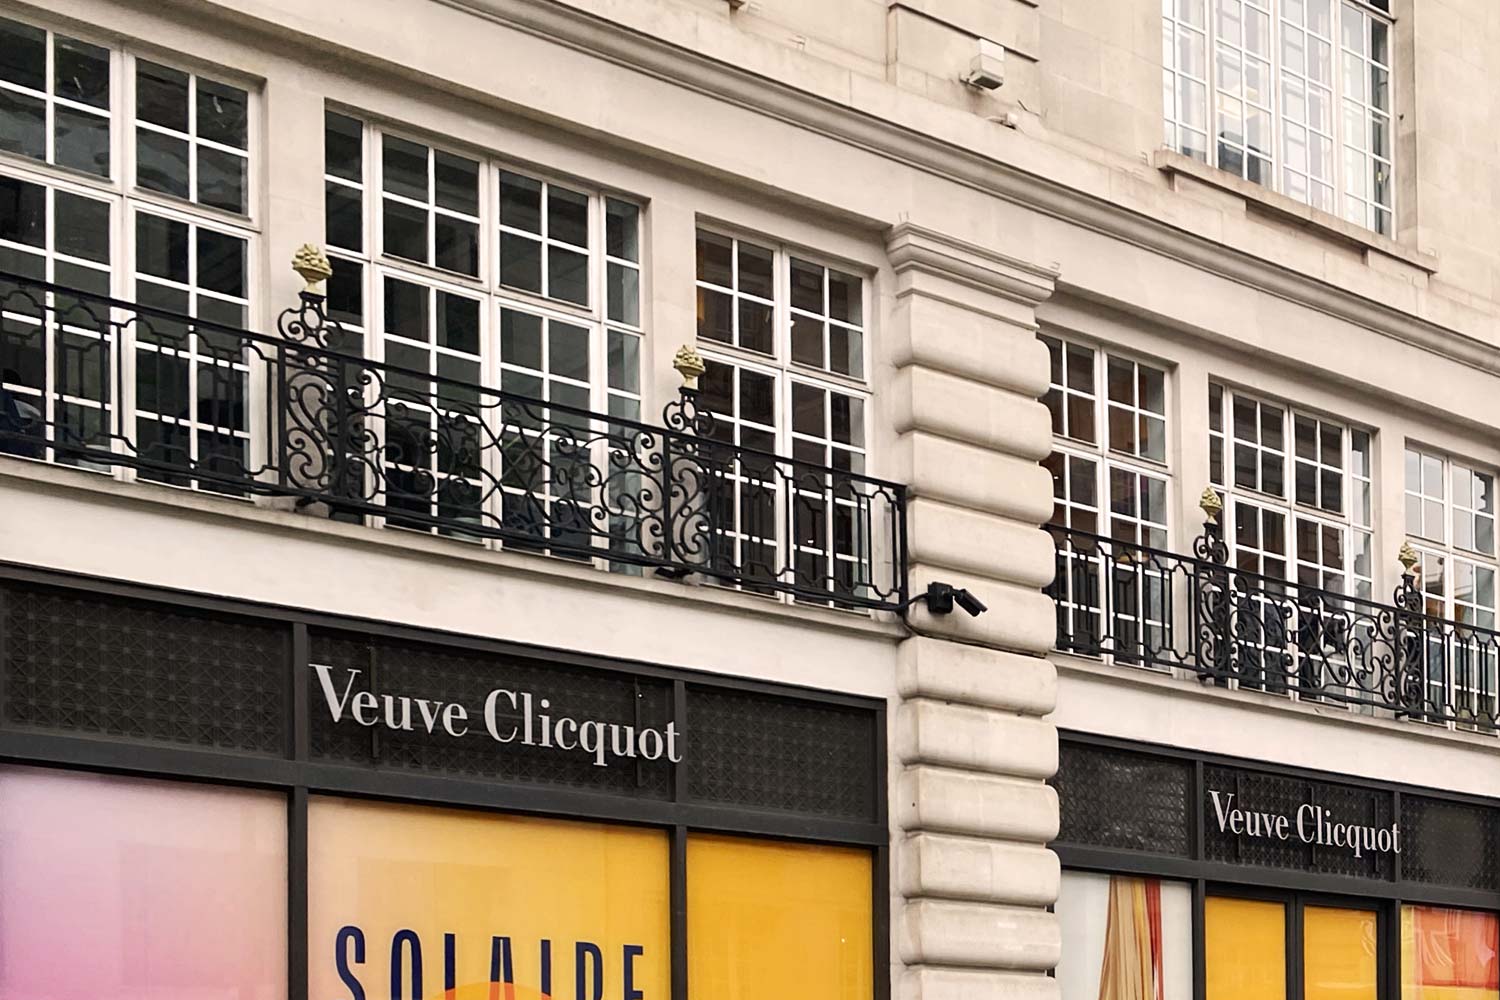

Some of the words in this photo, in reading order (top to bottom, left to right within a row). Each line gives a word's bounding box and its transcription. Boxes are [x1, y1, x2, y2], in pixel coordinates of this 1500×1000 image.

[308, 663, 468, 737] Veuve
[484, 688, 683, 767] Clicquot
[1207, 789, 1289, 840] Veuve
[1296, 803, 1402, 858] Clicquot
